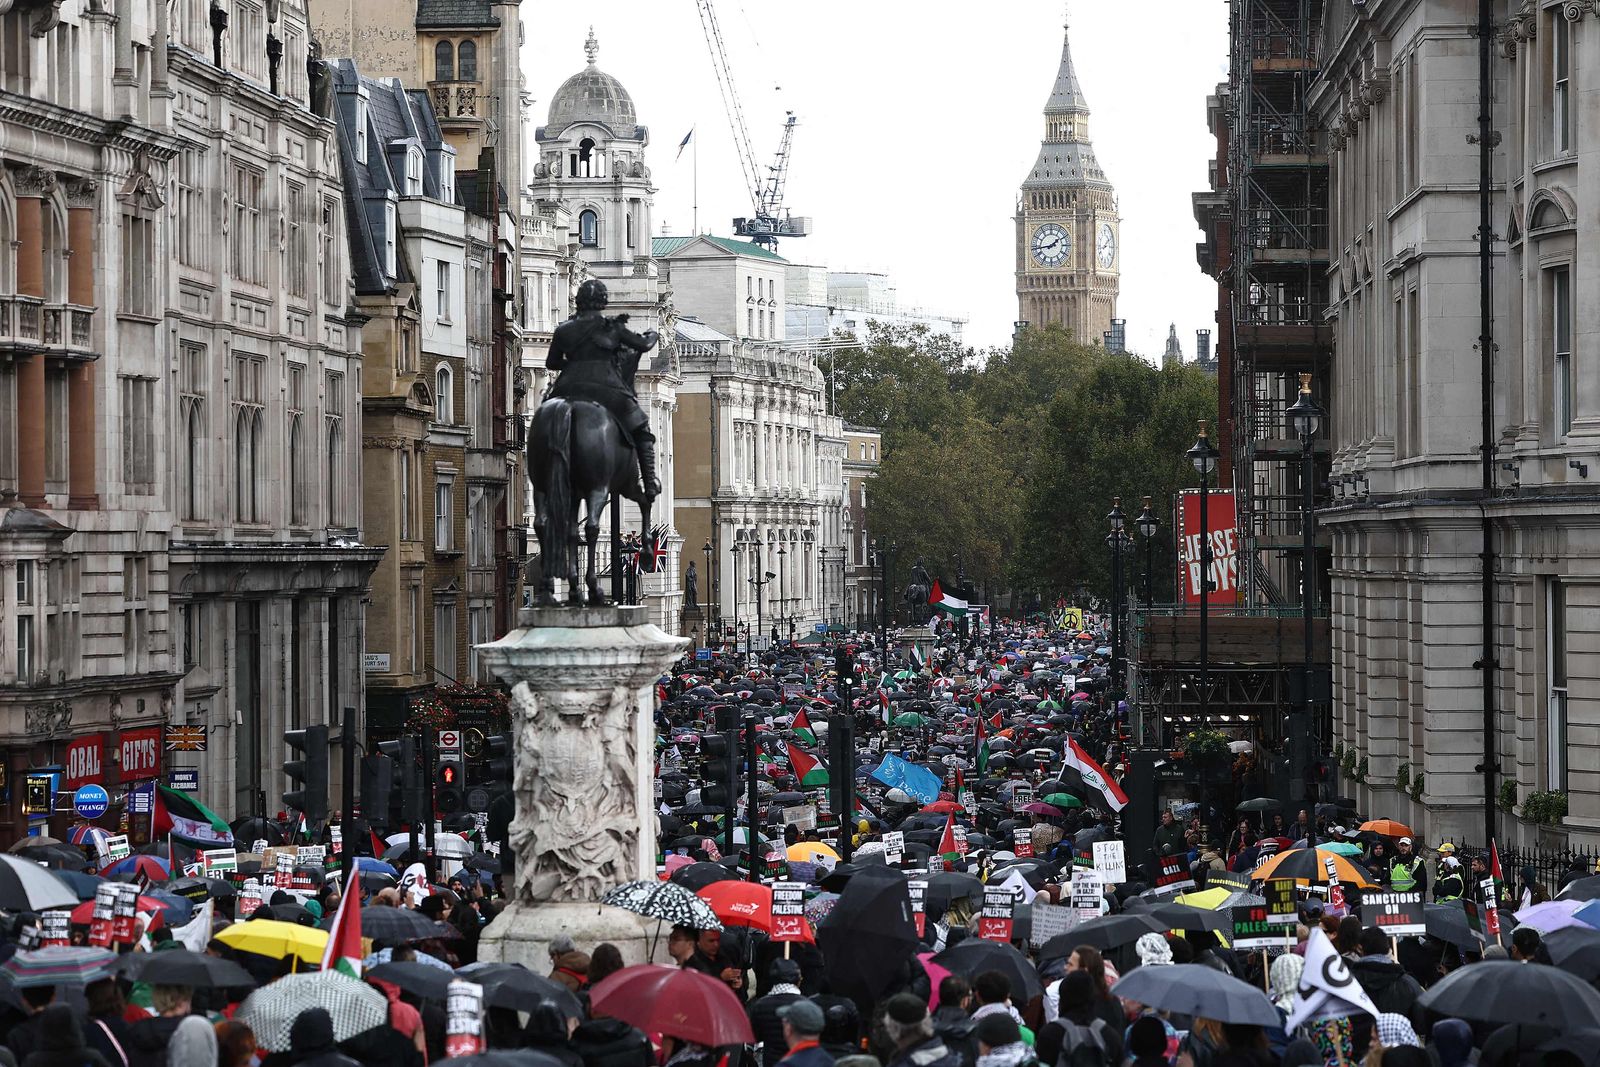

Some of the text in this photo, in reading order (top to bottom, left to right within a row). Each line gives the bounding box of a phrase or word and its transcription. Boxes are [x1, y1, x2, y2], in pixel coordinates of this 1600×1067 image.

[122, 738, 156, 772] GIFTS
[171, 782, 197, 790] EXCHANGE
[1013, 795, 1032, 803] FREE
[77, 804, 105, 812] CHANGE
[1096, 842, 1121, 853] STOP
[1163, 864, 1181, 875] GAZA
[774, 890, 803, 901] FREEDOM
[985, 894, 1012, 904] FREEDOM
[1362, 892, 1421, 905] SANCTIONS
[730, 903, 755, 916] Jersey
[772, 904, 804, 915] PALESTINE
[982, 907, 1012, 918] PALESTINE
[1385, 903, 1400, 914] ON
[1375, 914, 1411, 925] ISRAEL
